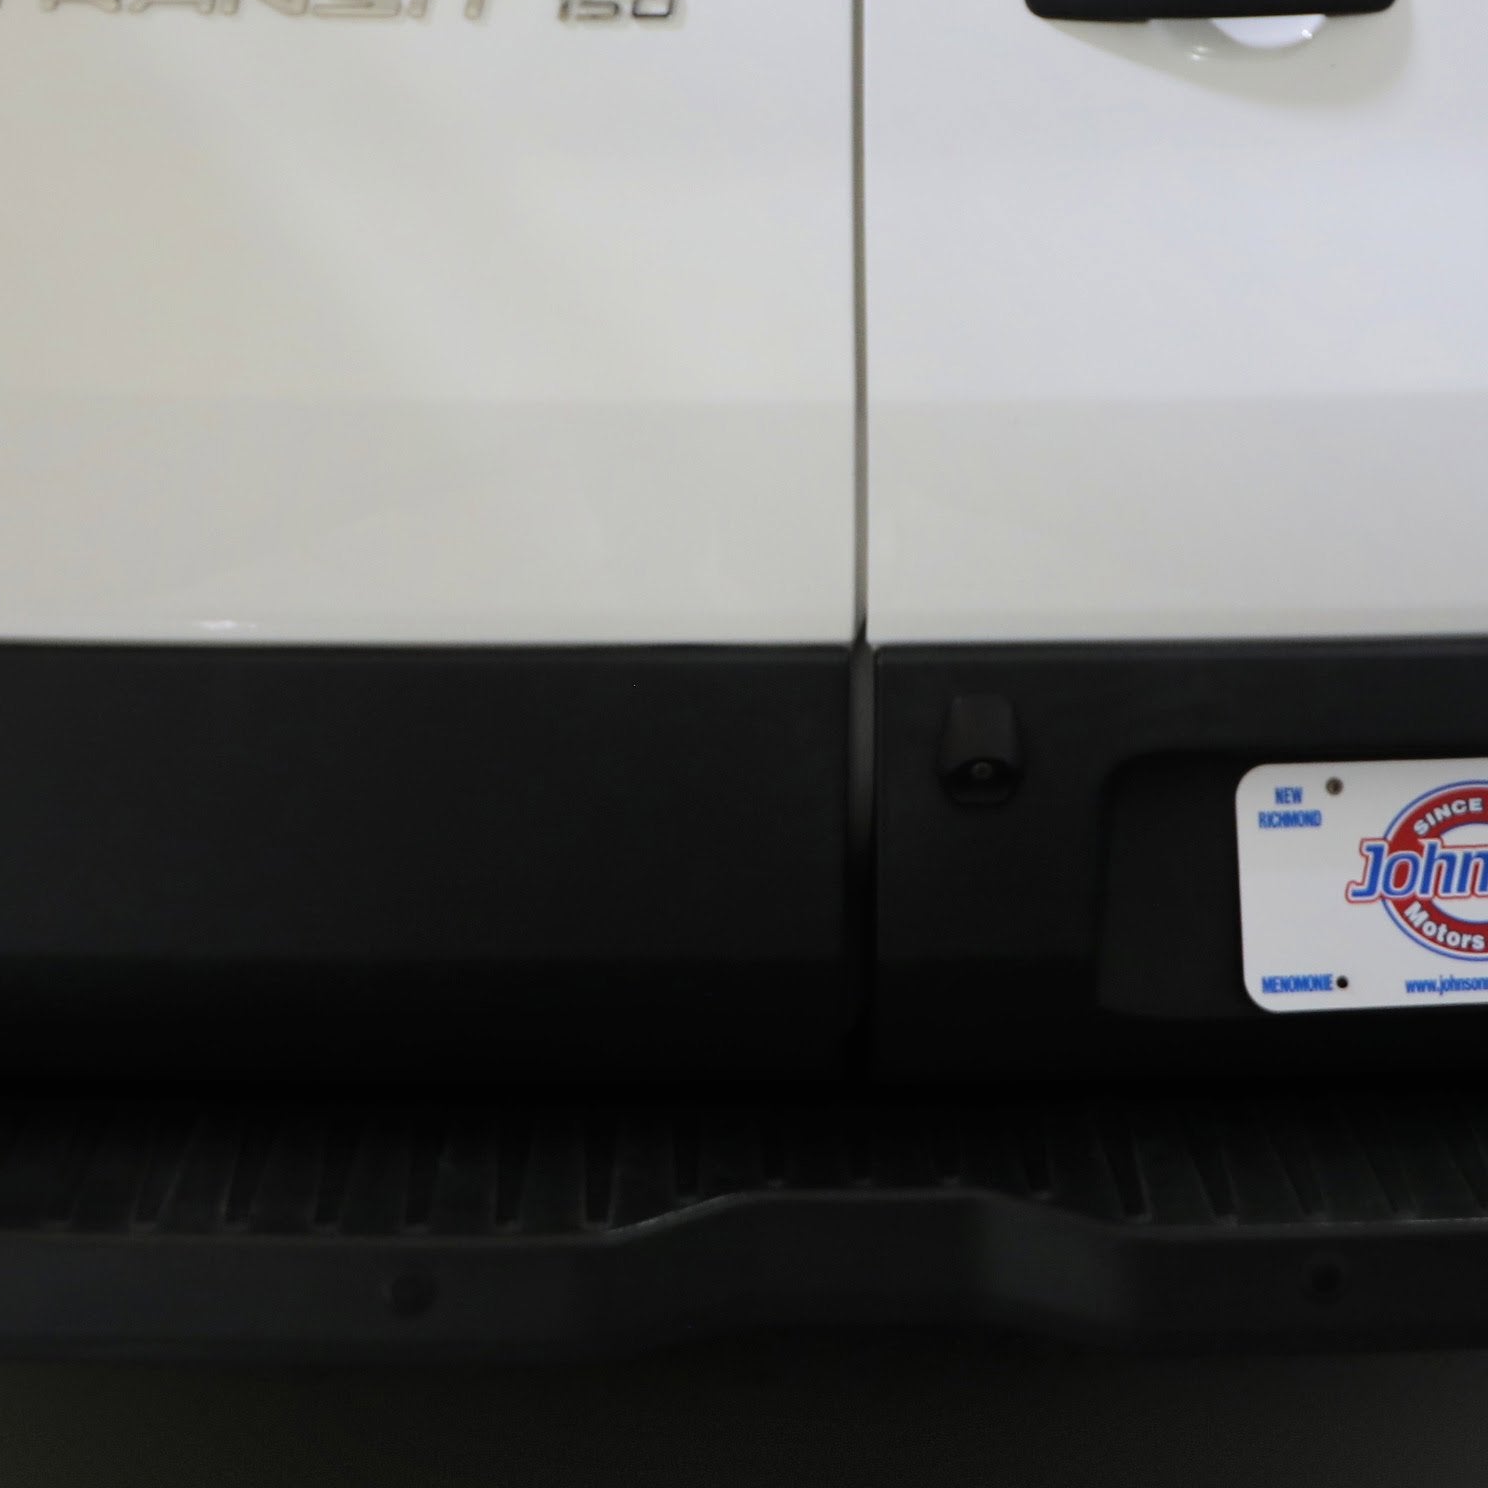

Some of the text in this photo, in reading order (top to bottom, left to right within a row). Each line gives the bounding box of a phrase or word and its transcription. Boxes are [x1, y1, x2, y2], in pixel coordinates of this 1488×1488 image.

[1274, 786, 1303, 805] NEW
[1258, 809, 1322, 829] RICHMOND
[1413, 797, 1484, 837] SINCE
[1402, 899, 1485, 952] Motors
[1261, 973, 1334, 994] MENOMONIE
